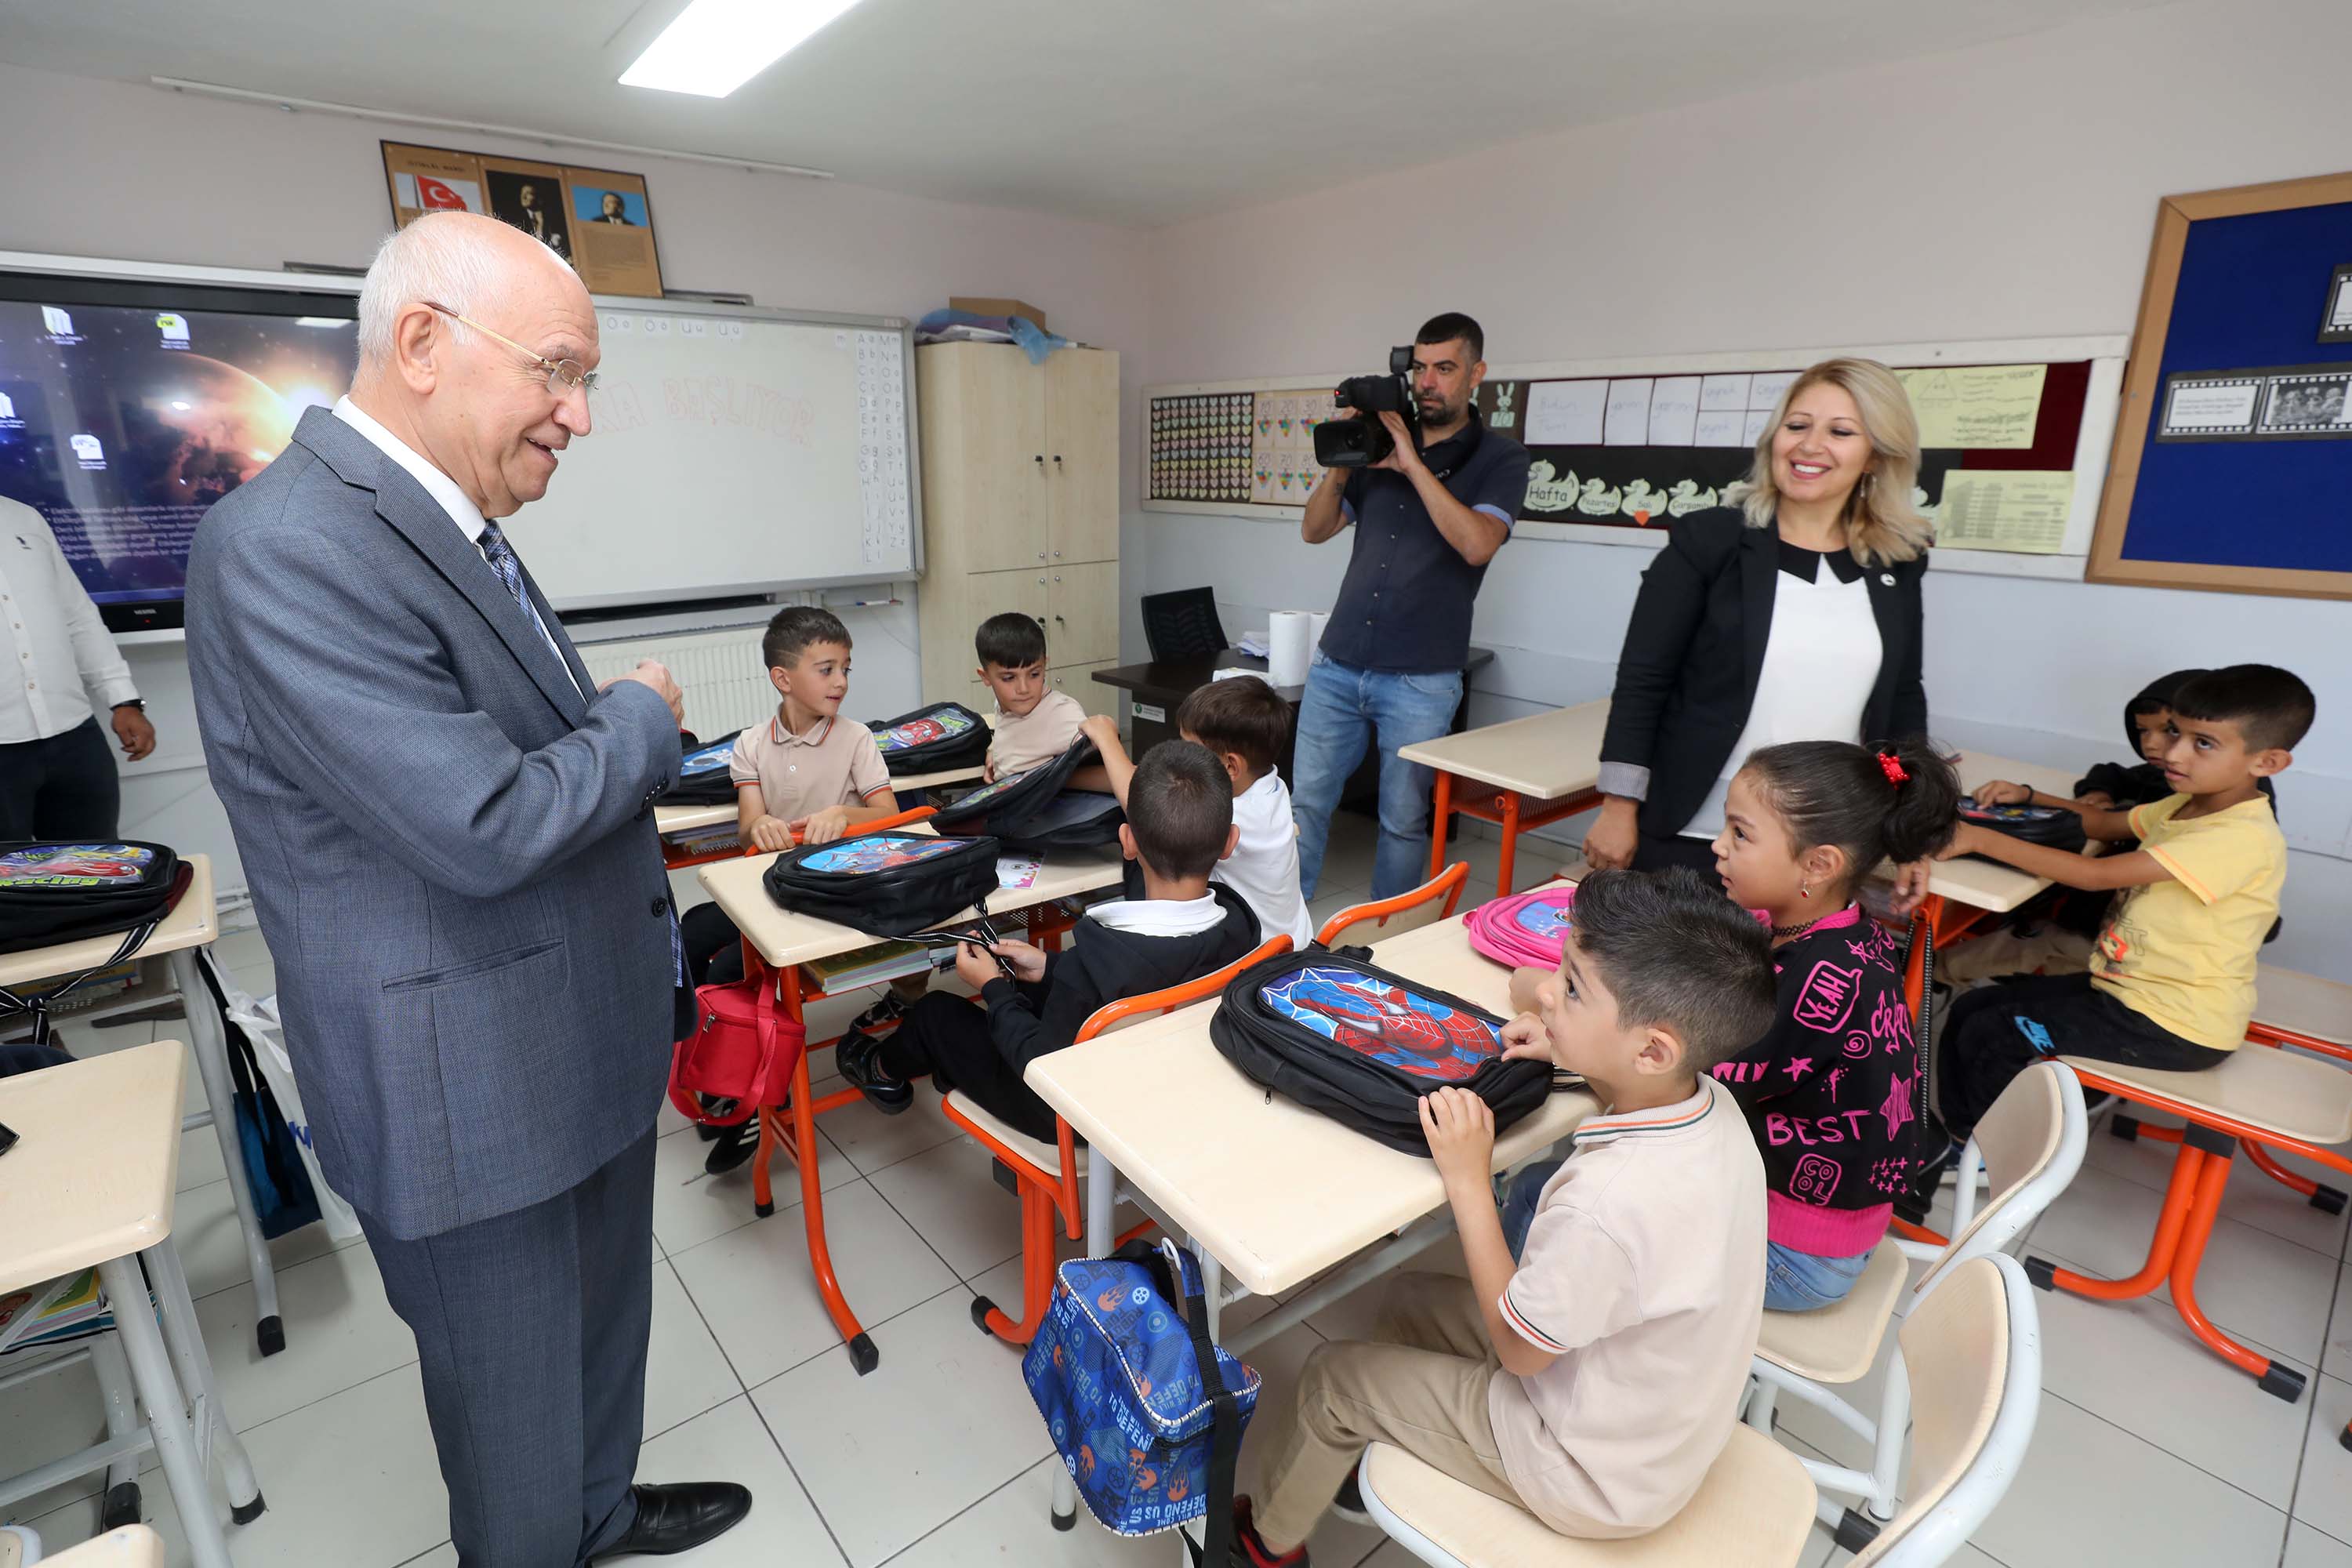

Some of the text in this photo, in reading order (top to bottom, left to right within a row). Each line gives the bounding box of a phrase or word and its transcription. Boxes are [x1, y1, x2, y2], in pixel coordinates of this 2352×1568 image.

[1528, 485, 1569, 503] Hafta
[1799, 970, 1851, 1022] YEAH
[1766, 1110, 1871, 1145] BEST
[1109, 1391, 1118, 1414] TO
[1145, 1505, 1160, 1519] US
[1164, 1493, 1207, 1519] DEFEND
